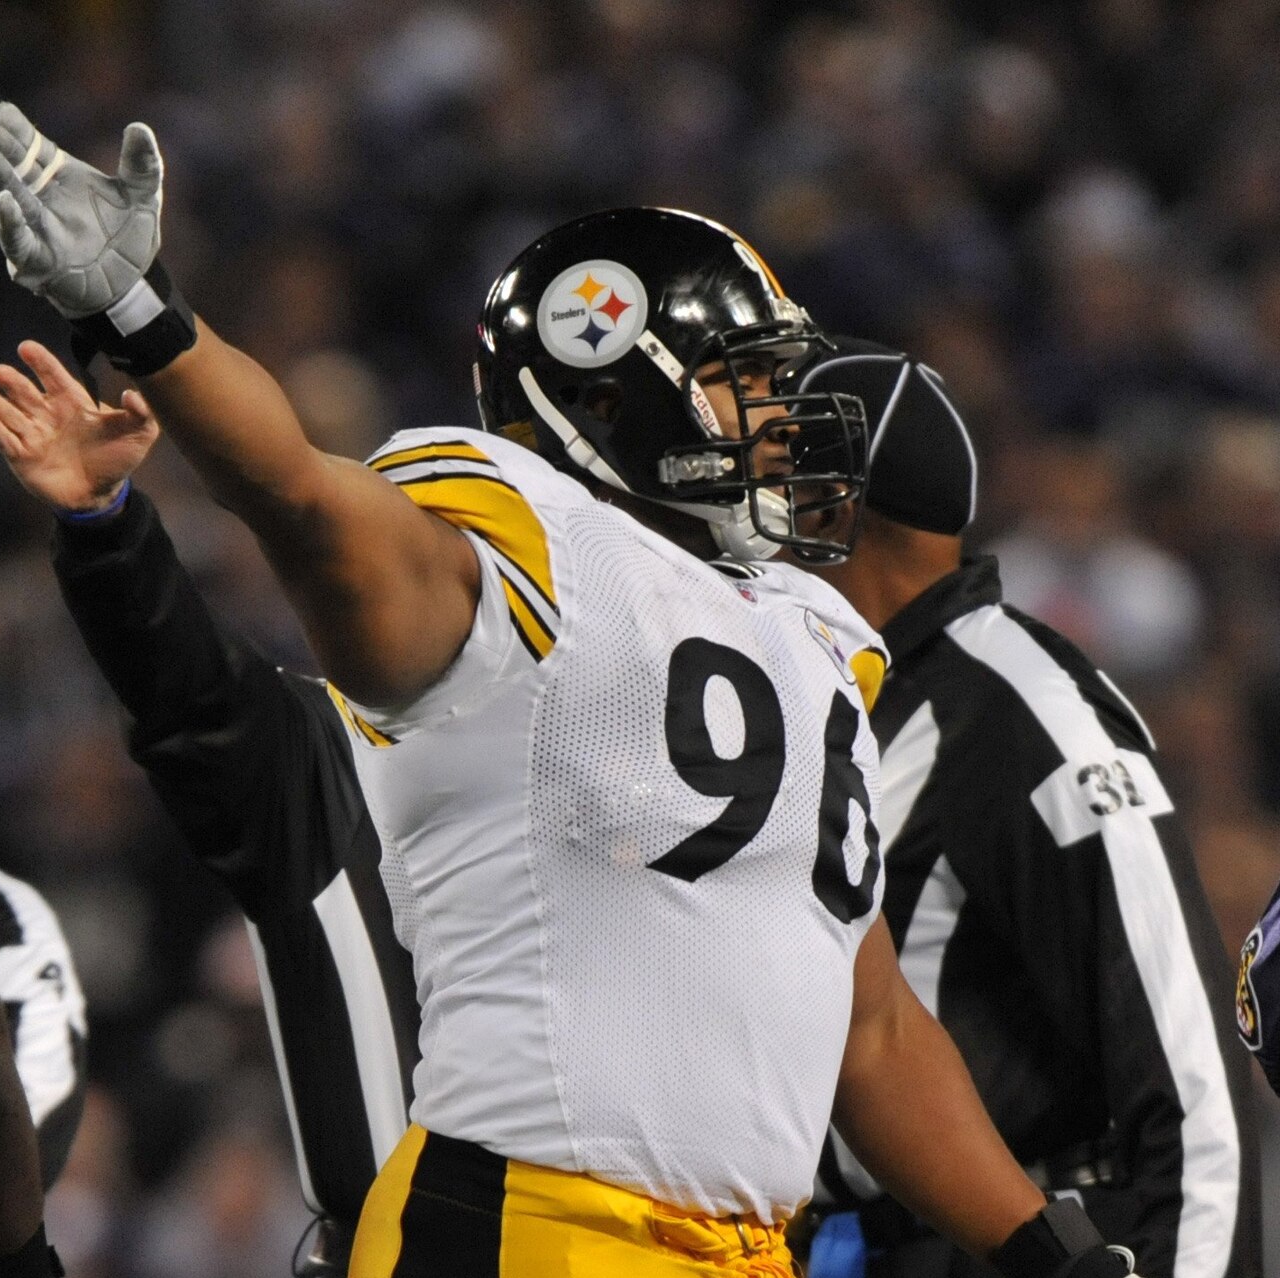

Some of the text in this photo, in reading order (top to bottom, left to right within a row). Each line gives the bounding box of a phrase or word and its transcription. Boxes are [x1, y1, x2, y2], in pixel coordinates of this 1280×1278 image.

[550, 307, 586, 322] Steelers
[646, 637, 880, 924] 96
[1075, 760, 1145, 816] 31
